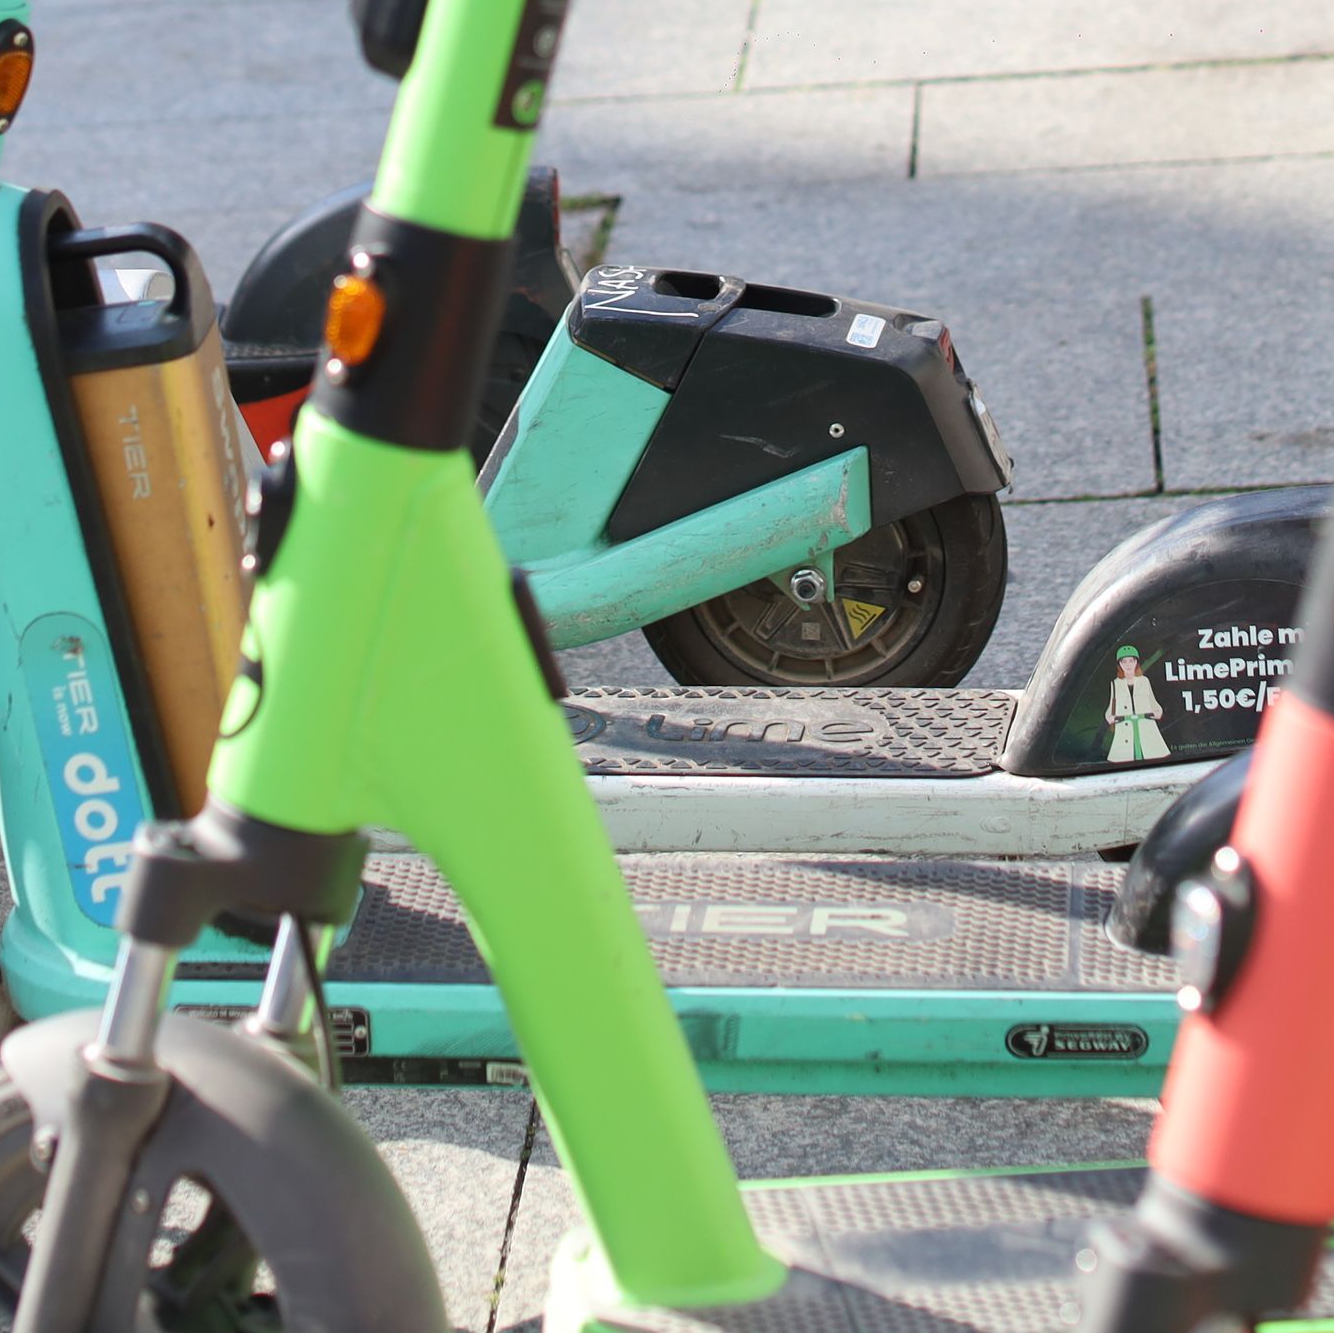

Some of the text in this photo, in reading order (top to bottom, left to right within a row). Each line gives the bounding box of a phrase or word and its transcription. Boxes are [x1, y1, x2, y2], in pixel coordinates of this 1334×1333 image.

[119, 404, 153, 501] TIER
[1198, 625, 1274, 649] Zahle
[55, 701, 72, 736] now
[63, 751, 135, 905] dott
[1054, 1040, 1131, 1051] SEGWAY
